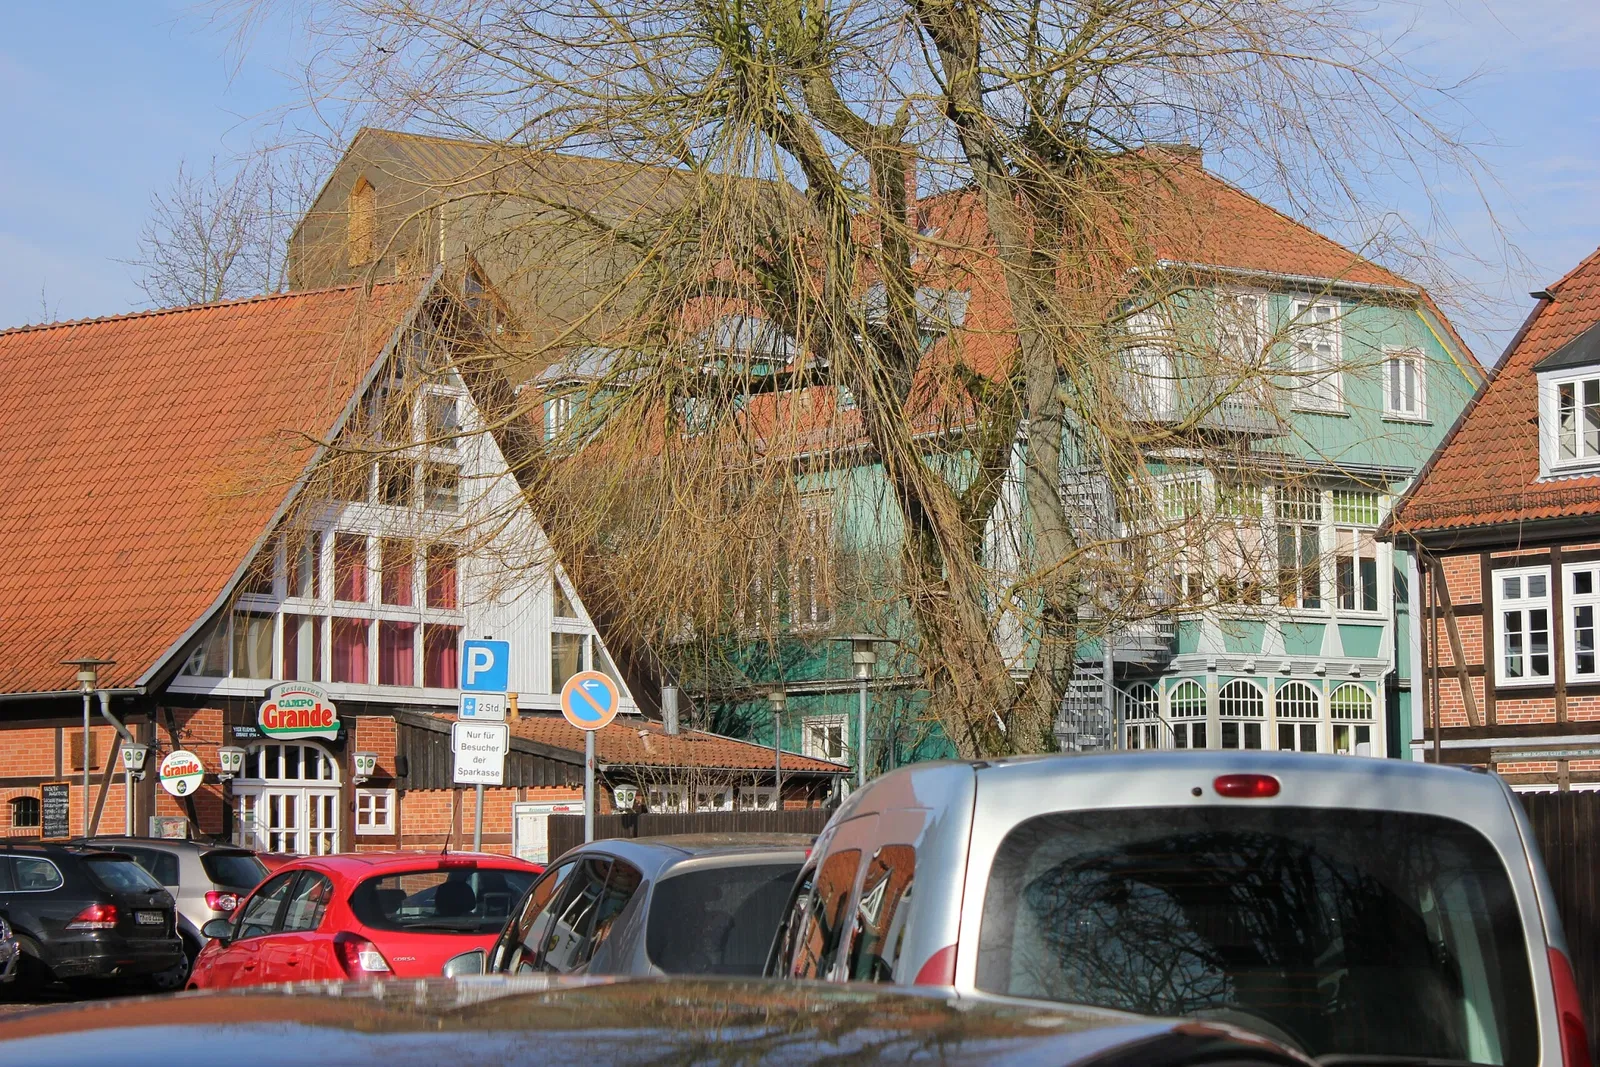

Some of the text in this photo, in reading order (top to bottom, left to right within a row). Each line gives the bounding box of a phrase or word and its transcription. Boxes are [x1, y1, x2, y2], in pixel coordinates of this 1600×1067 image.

[466, 647, 495, 685] P
[280, 685, 323, 698] Restaurant
[278, 699, 314, 708] CAMPO
[478, 703, 501, 712] 2 Std.
[263, 703, 333, 729] Grande
[467, 730, 495, 740] Nur für
[461, 743, 499, 752] Besucher
[472, 756, 486, 764] der
[163, 761, 199, 777] Grande
[458, 767, 500, 777] Sparkasse
